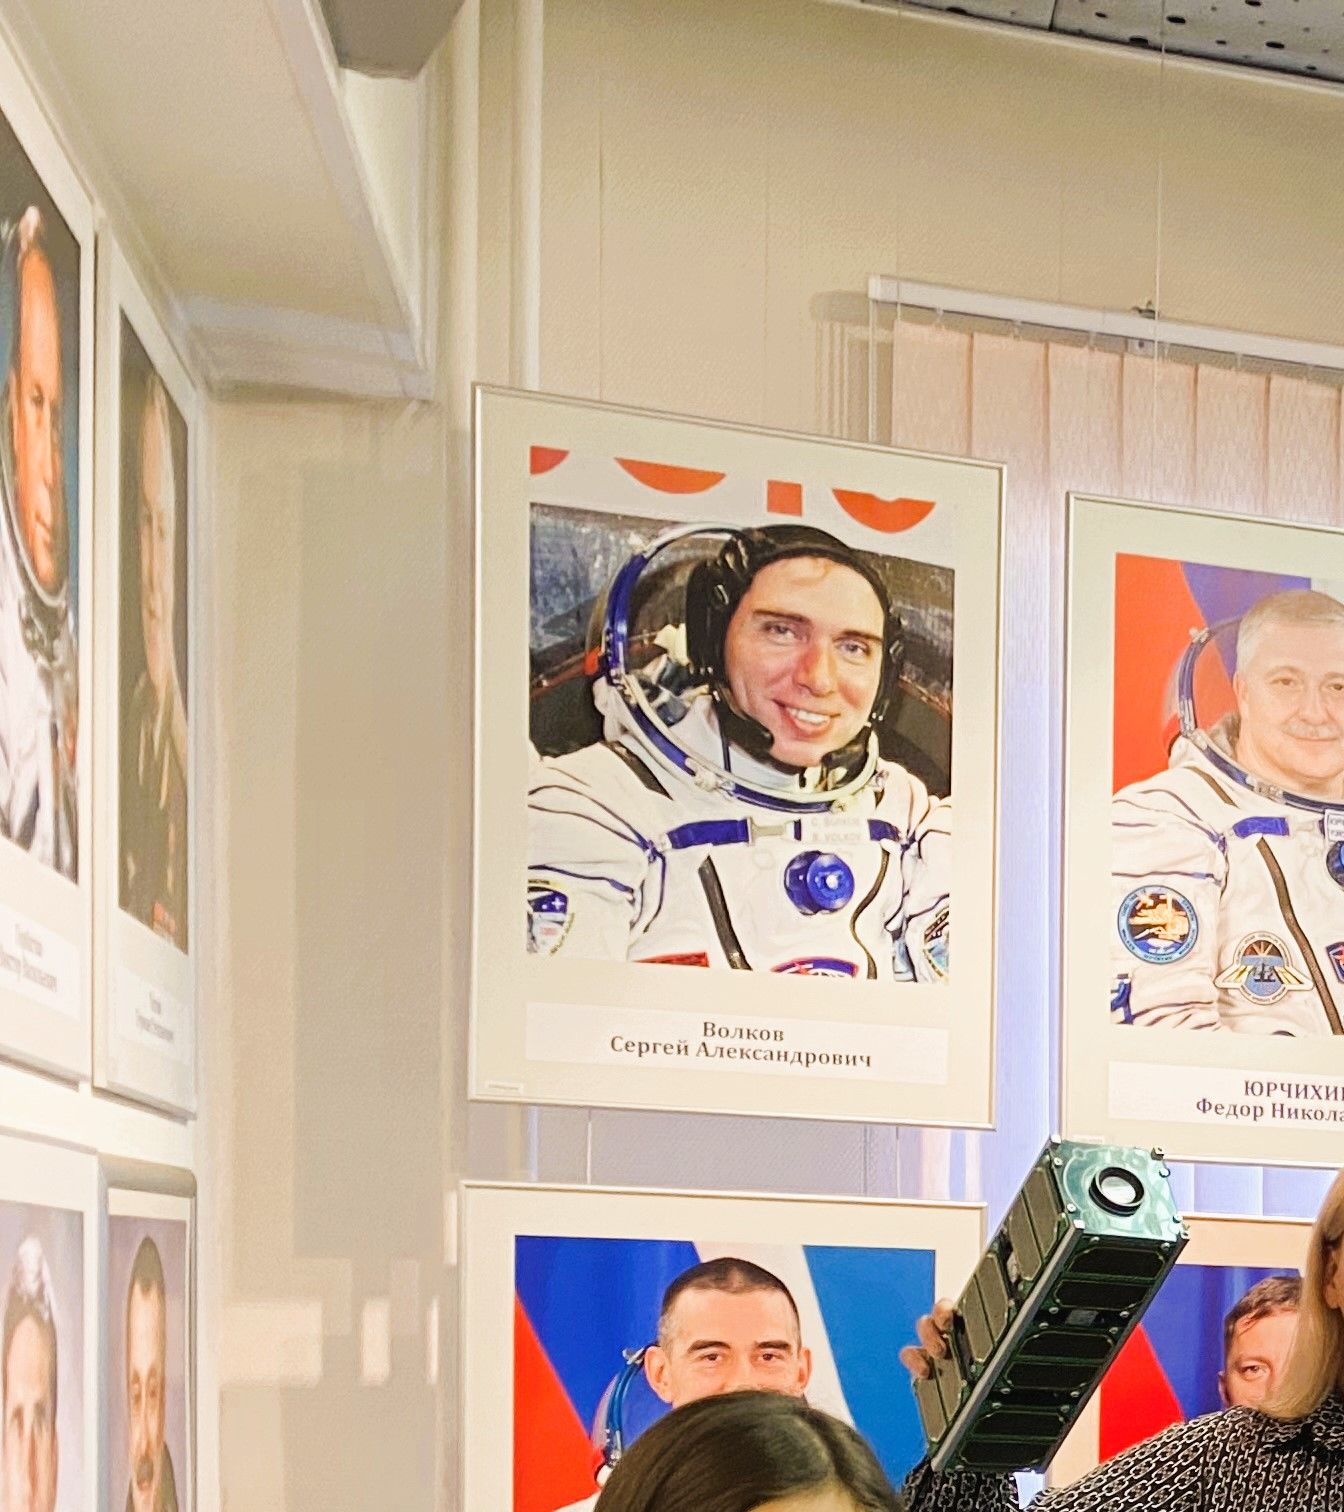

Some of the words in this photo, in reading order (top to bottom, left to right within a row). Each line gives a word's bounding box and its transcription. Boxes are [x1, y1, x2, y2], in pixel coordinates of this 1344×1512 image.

[703, 1021, 785, 1042] Волков
[610, 1035, 689, 1057] Сергей
[696, 1041, 872, 1068] Александрович
[1196, 1098, 1264, 1120] Федор
